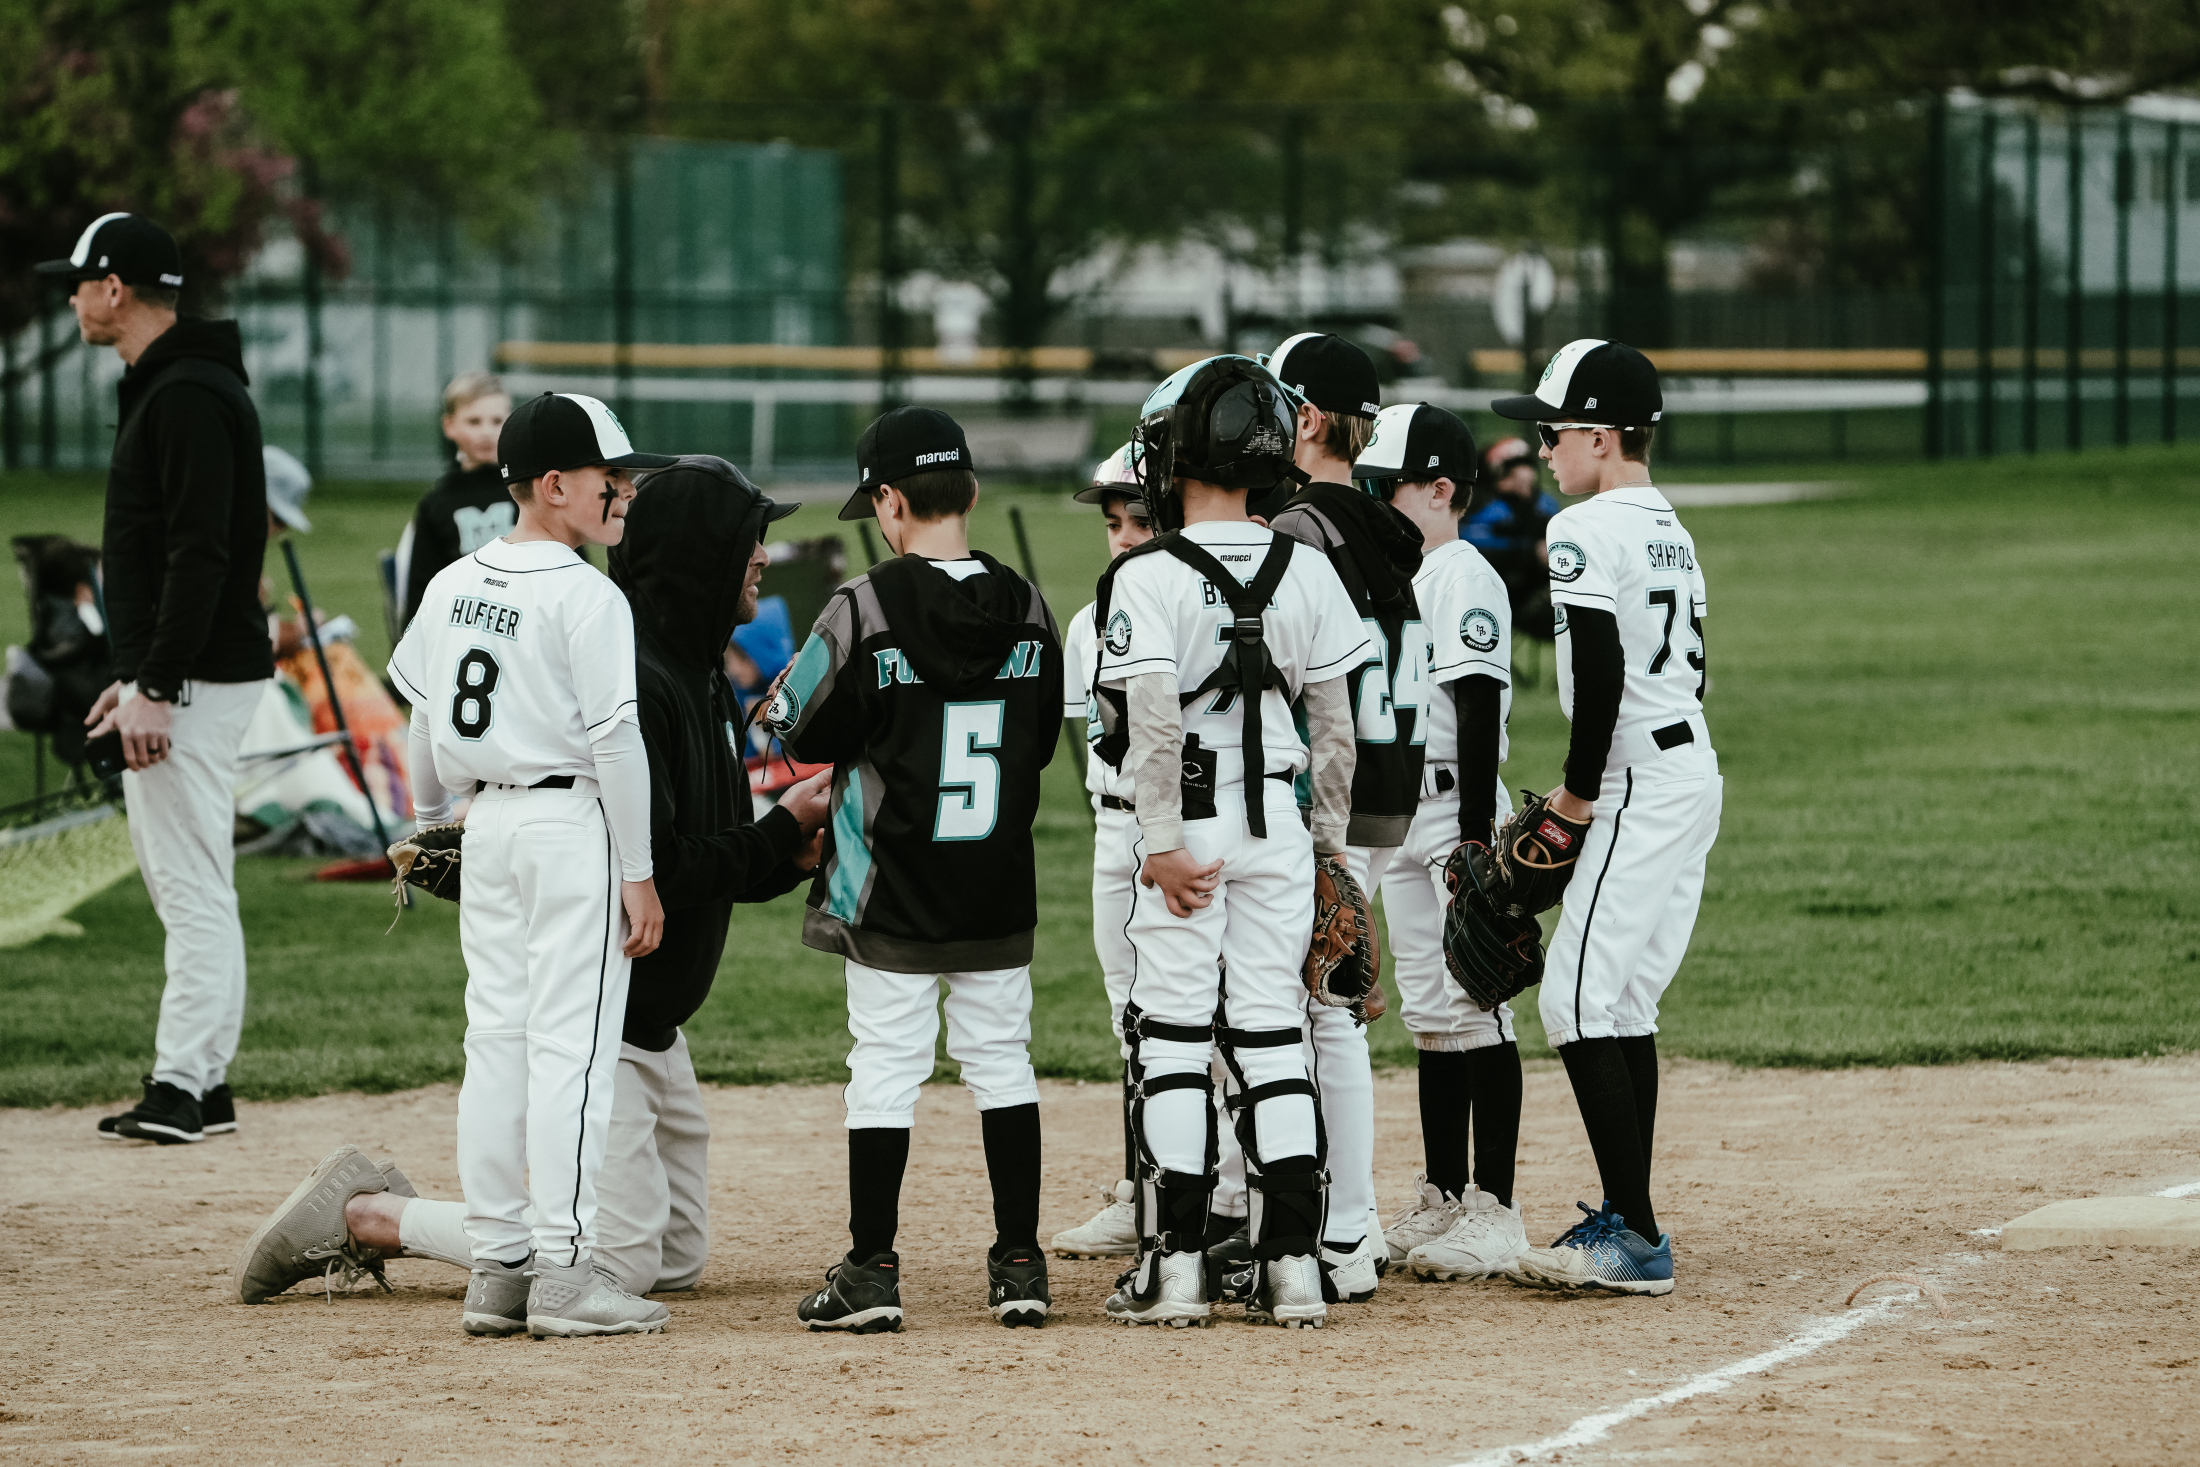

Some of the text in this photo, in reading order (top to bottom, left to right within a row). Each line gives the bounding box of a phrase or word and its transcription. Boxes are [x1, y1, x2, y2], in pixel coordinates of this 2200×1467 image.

[915, 447, 959, 467] marucci
[1220, 553, 1252, 562] marucci
[449, 595, 523, 641] HUFFER
[449, 644, 502, 742] 8
[932, 699, 1006, 842] 5
